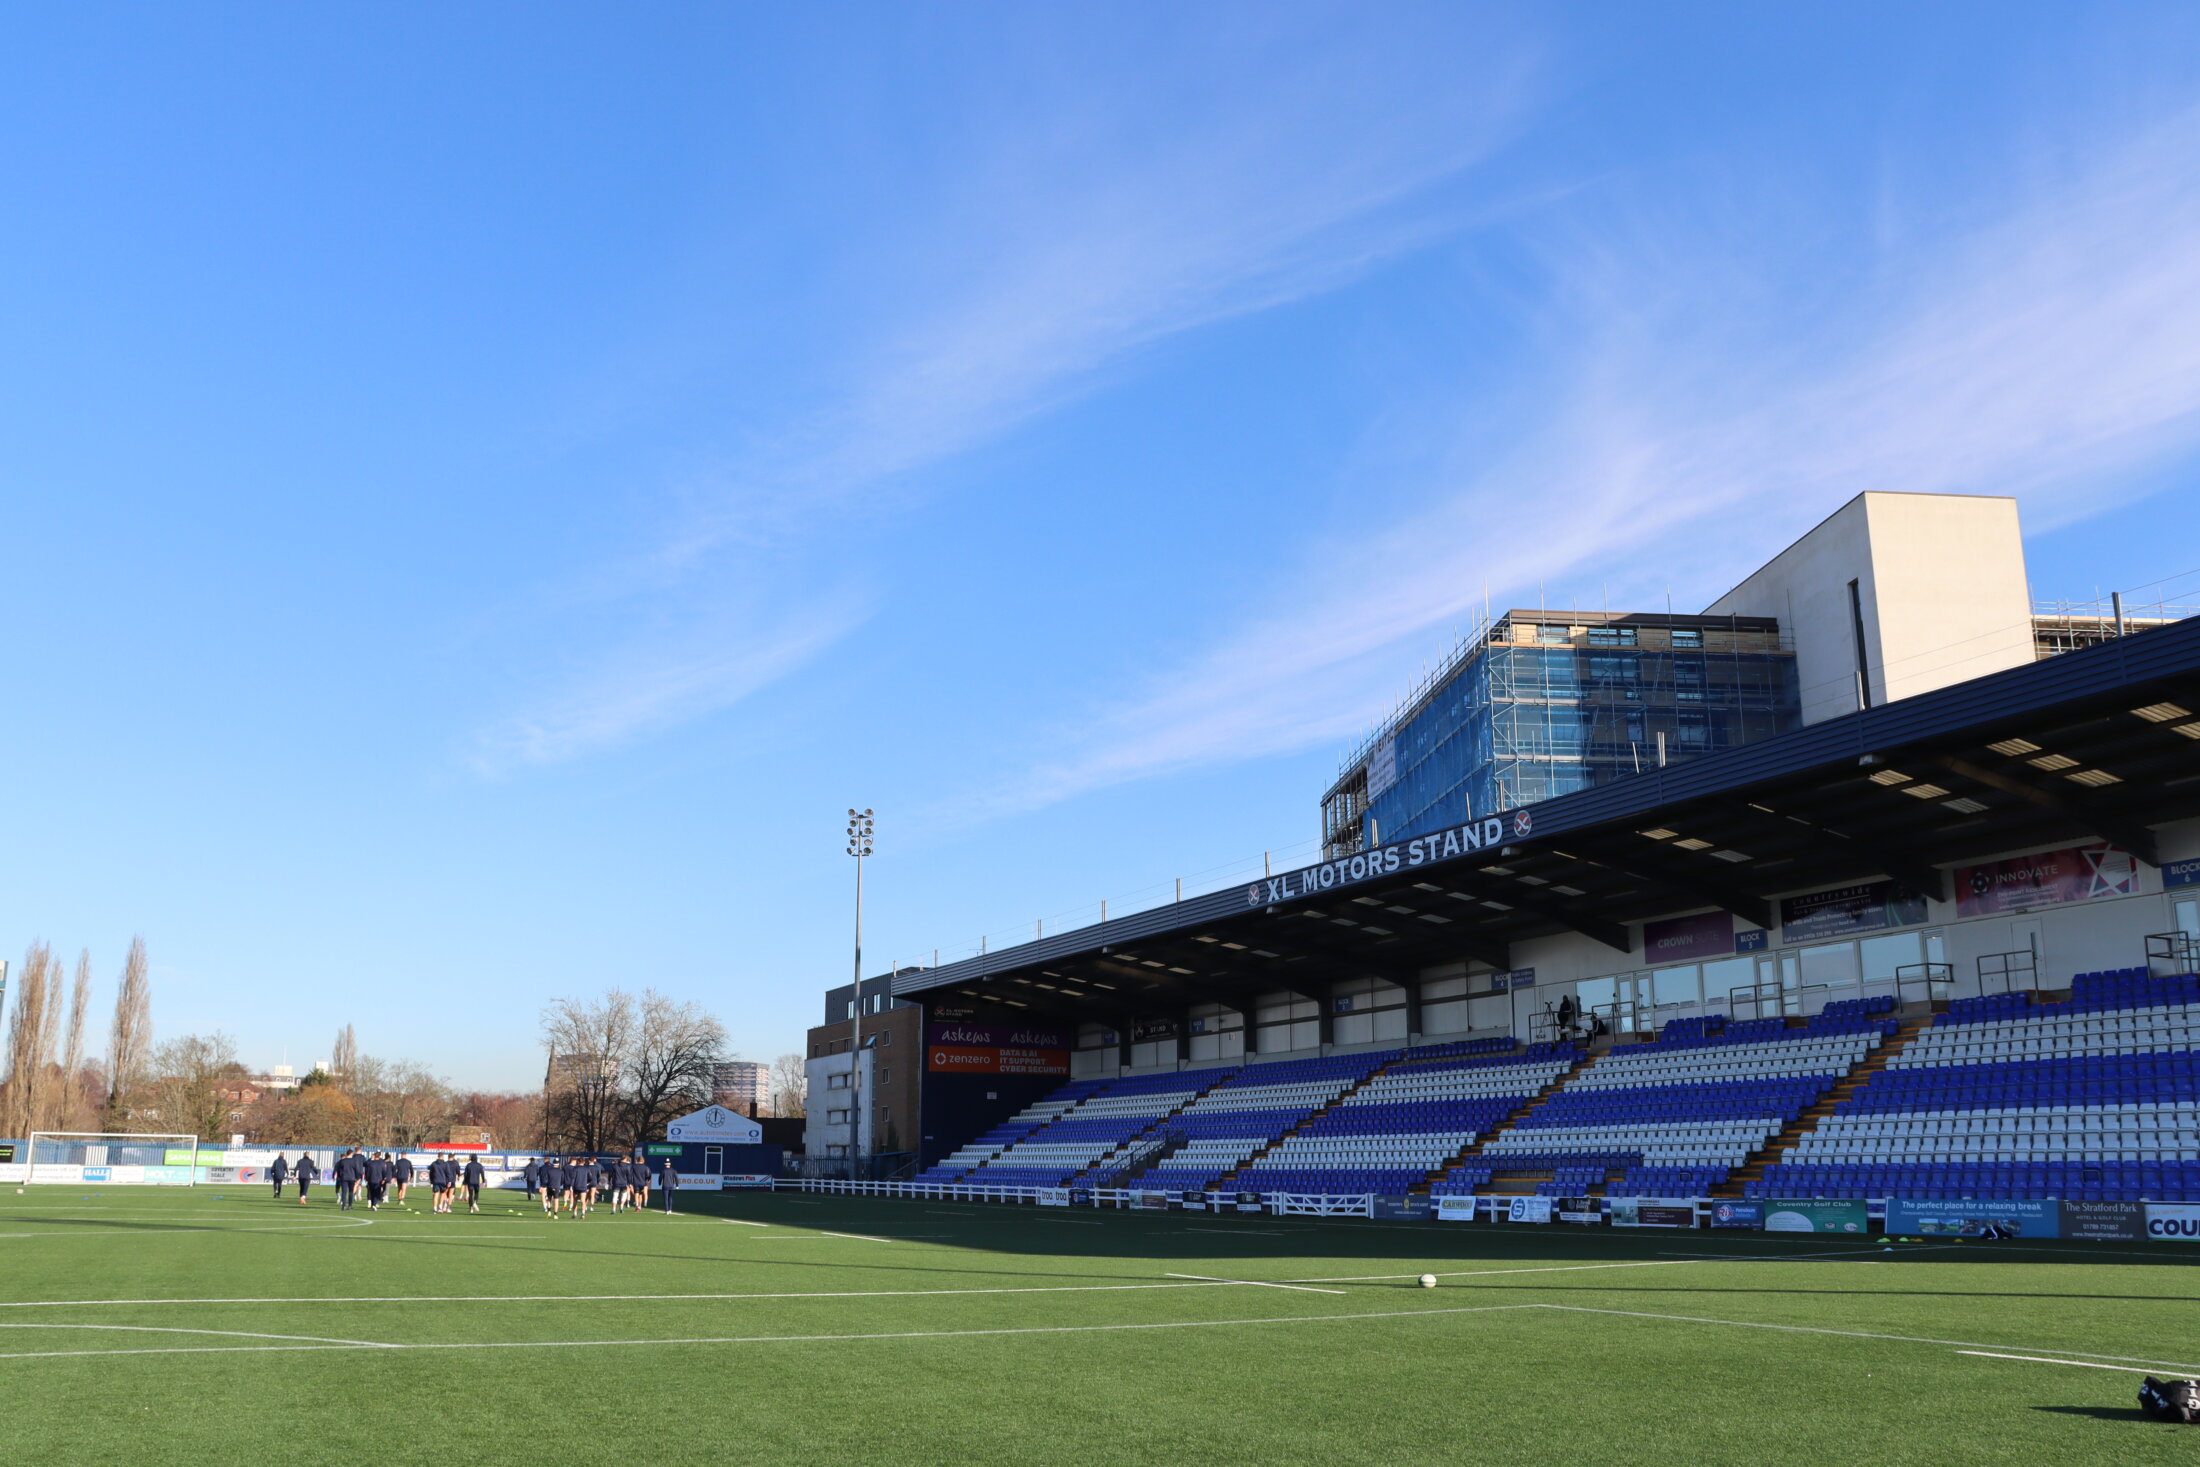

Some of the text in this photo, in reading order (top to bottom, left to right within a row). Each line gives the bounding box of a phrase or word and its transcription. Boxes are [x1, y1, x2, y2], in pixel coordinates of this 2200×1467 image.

[1267, 818, 1502, 903] XL MOTORS STAND
[1995, 865, 2059, 884] INNOVATE
[2184, 874, 2191, 882] 6
[1657, 935, 1693, 949] CROWN
[1741, 932, 1760, 942] BLOCK
[942, 1027, 991, 1044] askews
[1010, 1030, 1058, 1046] askews
[949, 1055, 991, 1064] zenzero
[1028, 1066, 1067, 1074] SECURITY
[1902, 1201, 1915, 1209] The
[1917, 1201, 1942, 1210] perfect
[1945, 1202, 1964, 1211] place
[1985, 1202, 2016, 1212] relaxing
[2065, 1203, 2137, 1212] The Stratford Park
[1717, 1208, 1734, 1217] Rix
[2149, 1219, 2200, 1236] COU
